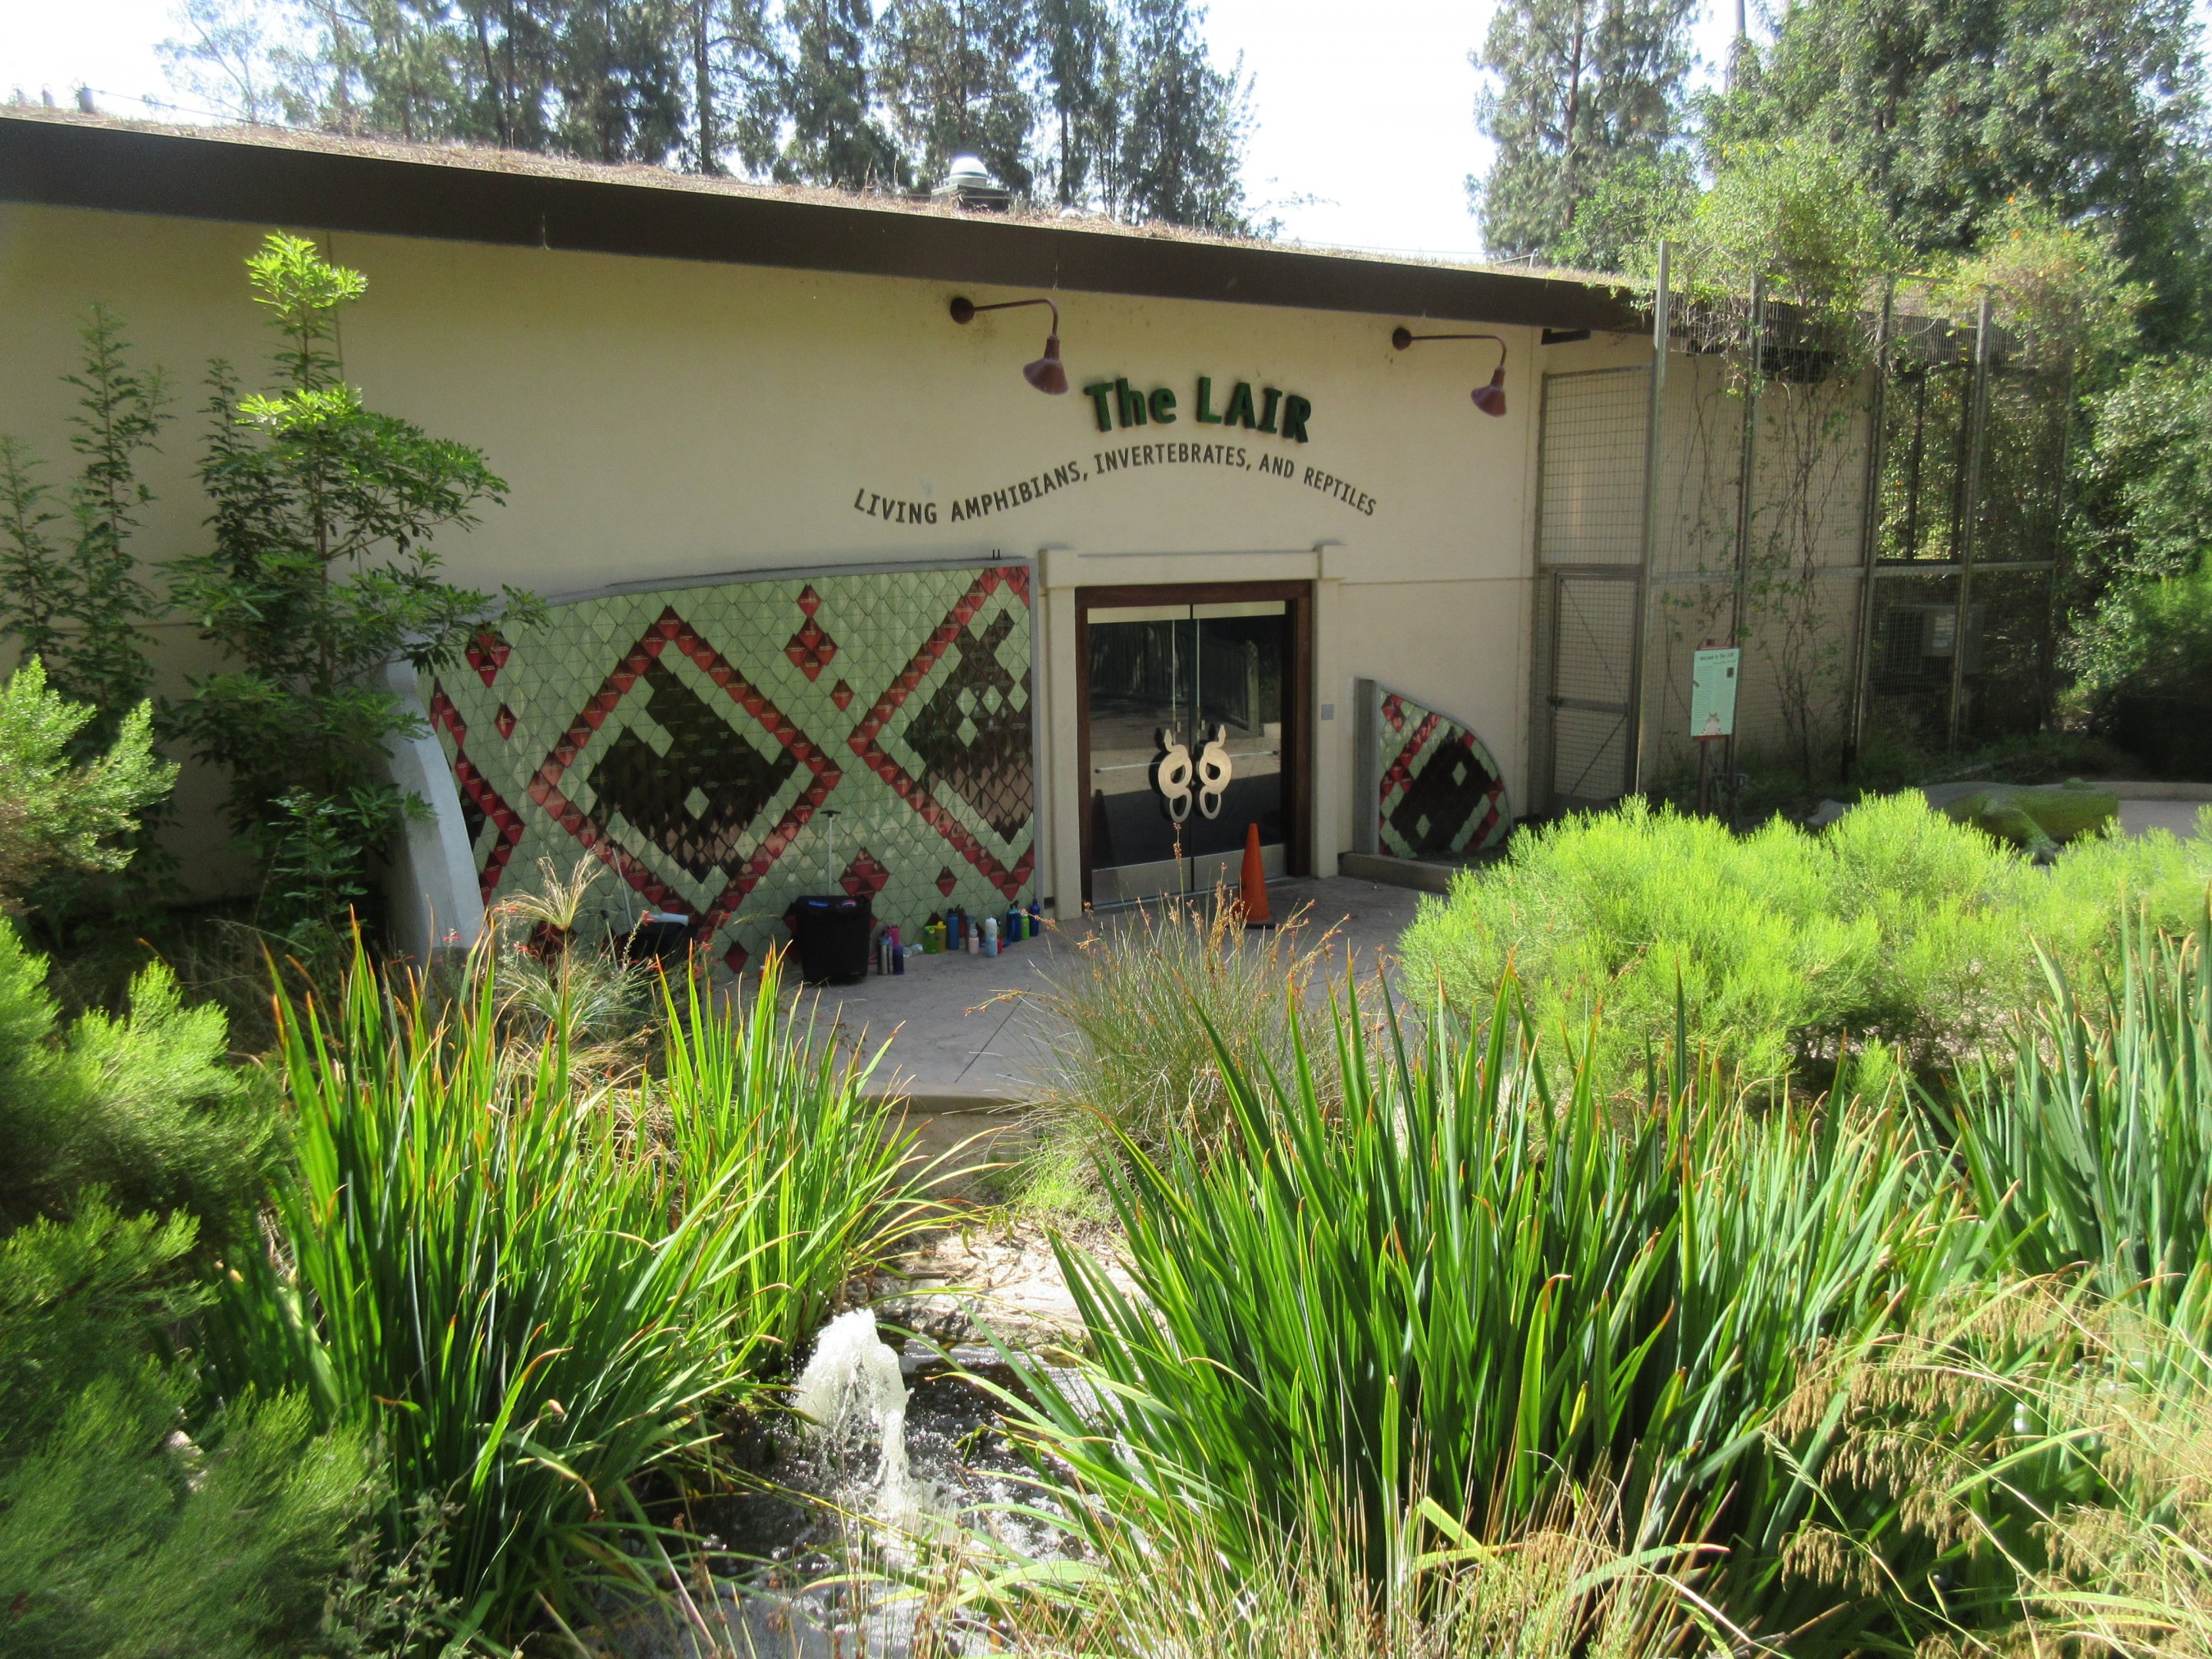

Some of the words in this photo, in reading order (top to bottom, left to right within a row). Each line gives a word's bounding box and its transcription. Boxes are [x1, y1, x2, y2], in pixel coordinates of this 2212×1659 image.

[1084, 377, 1177, 432] The
[1196, 376, 1312, 443] LAIR
[854, 488, 937, 524] LIVING
[951, 461, 1088, 522] AMPHIBIANS,
[1094, 443, 1253, 475] INVERTEBRATES,
[1259, 453, 1295, 479] AND
[1303, 466, 1377, 517] REPTILES
